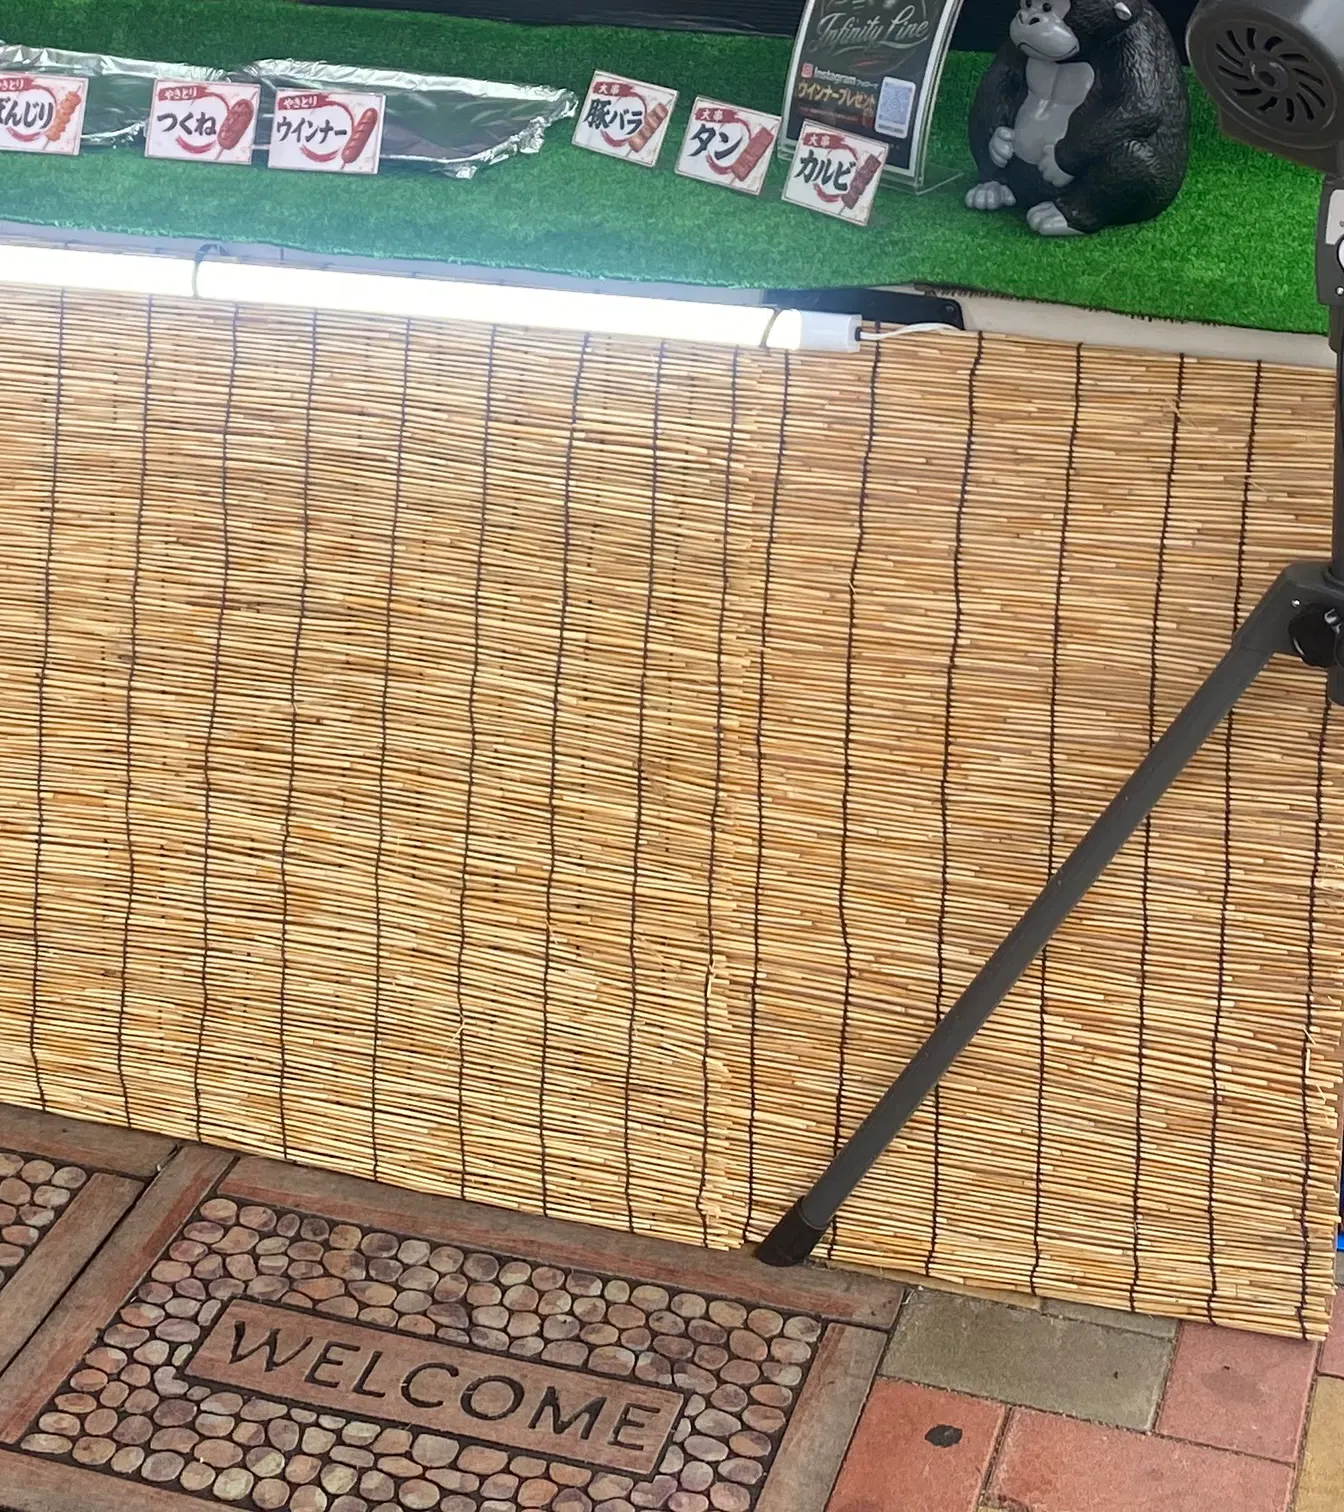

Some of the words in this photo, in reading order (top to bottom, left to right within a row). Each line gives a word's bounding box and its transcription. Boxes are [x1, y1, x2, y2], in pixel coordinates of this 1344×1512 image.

[814, 66, 856, 85] Instagram
[164, 87, 197, 100] やきとり
[599, 83, 620, 95] 大串
[284, 96, 318, 109] やきとり
[156, 111, 217, 138] つくね
[584, 99, 643, 136] 豚バラ
[702, 109, 723, 121] 大串
[275, 115, 348, 144] ウインナー
[808, 134, 830, 147] 大串
[689, 123, 744, 161] タン
[794, 150, 856, 192] カルビ
[229, 1320, 660, 1452] WELCOME
